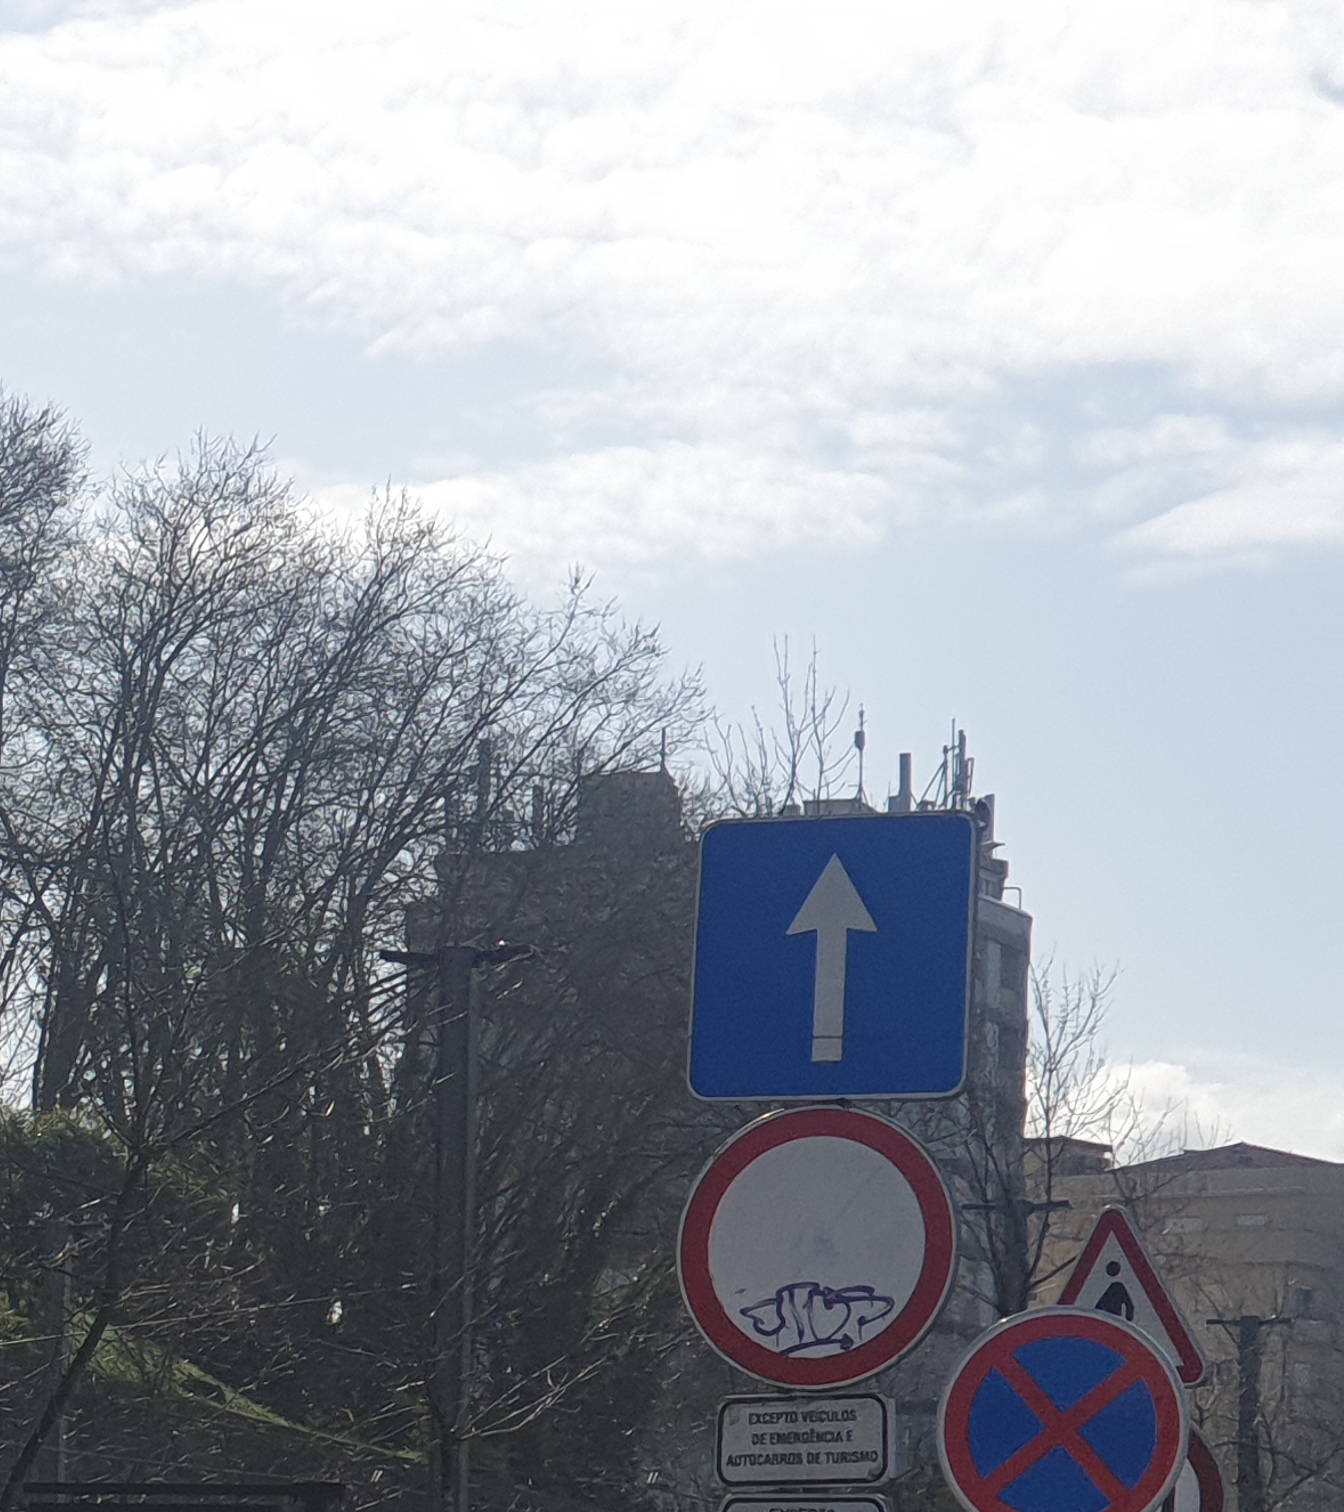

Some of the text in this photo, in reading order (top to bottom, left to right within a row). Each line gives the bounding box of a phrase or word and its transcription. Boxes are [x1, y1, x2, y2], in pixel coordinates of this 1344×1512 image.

[749, 1412, 798, 1425] EXCEPTO
[726, 1450, 879, 1467] AUTOCARROS DE TURISMO
